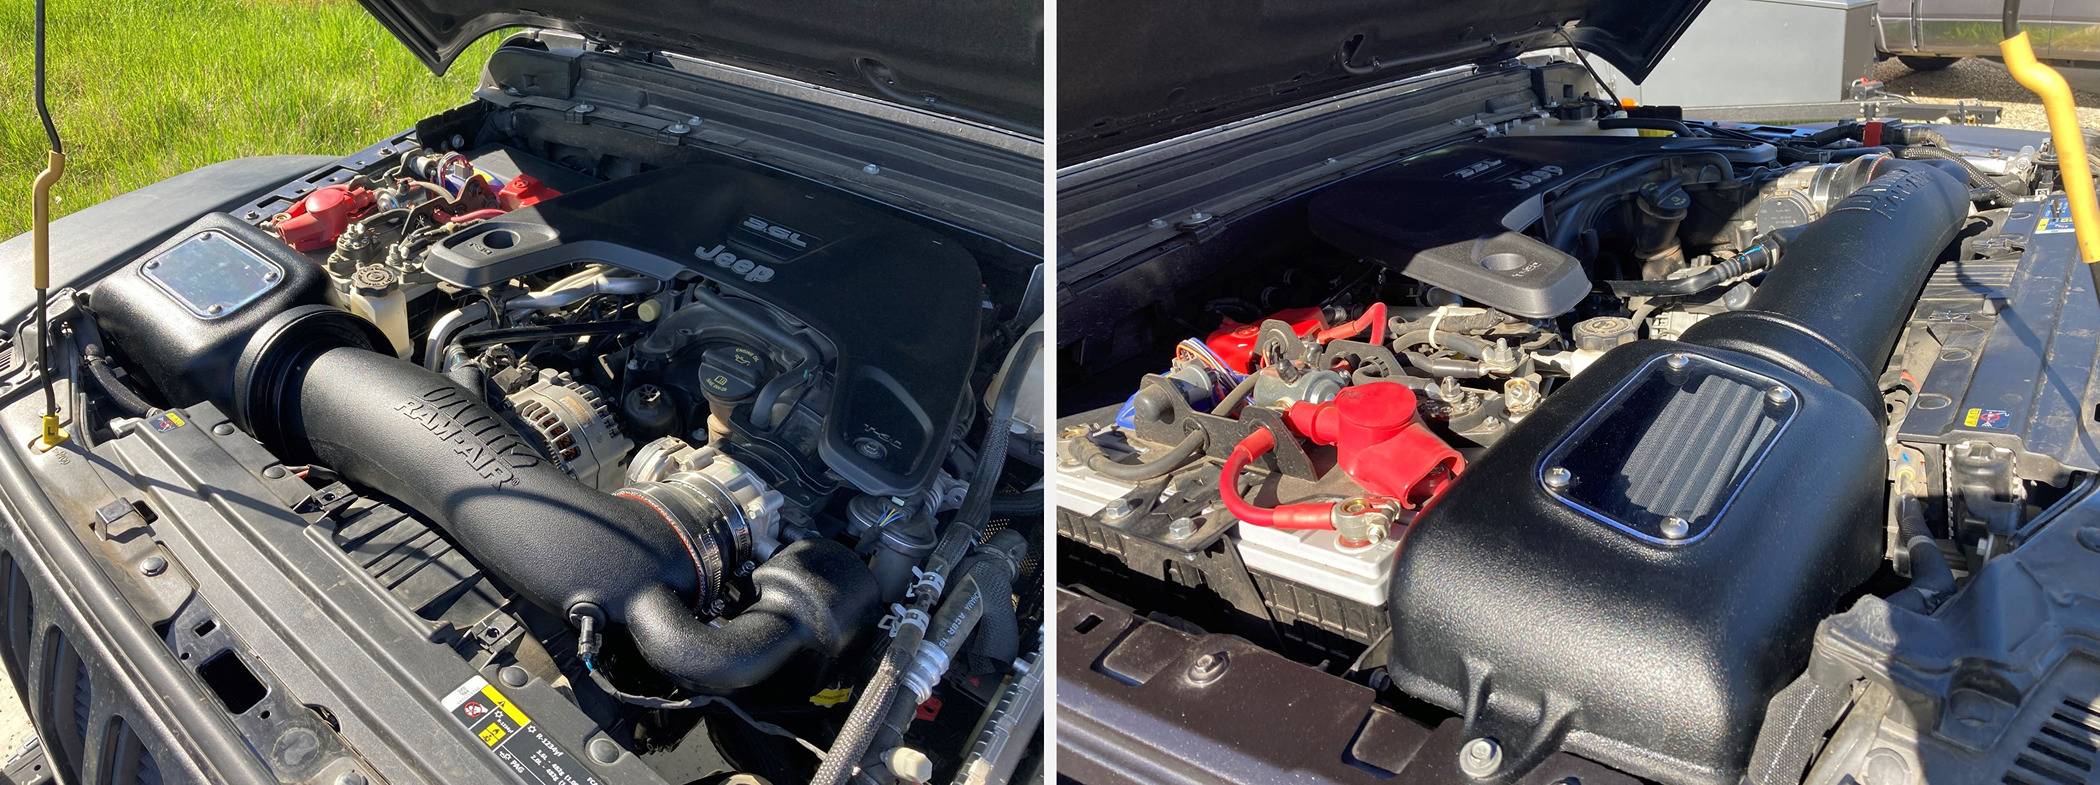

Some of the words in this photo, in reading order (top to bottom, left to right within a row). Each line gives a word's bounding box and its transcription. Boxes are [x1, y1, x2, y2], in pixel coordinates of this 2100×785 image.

[694, 244, 776, 283] Jeep
[536, 733, 565, 757] R-1234yf
[510, 760, 525, 773] PAG
